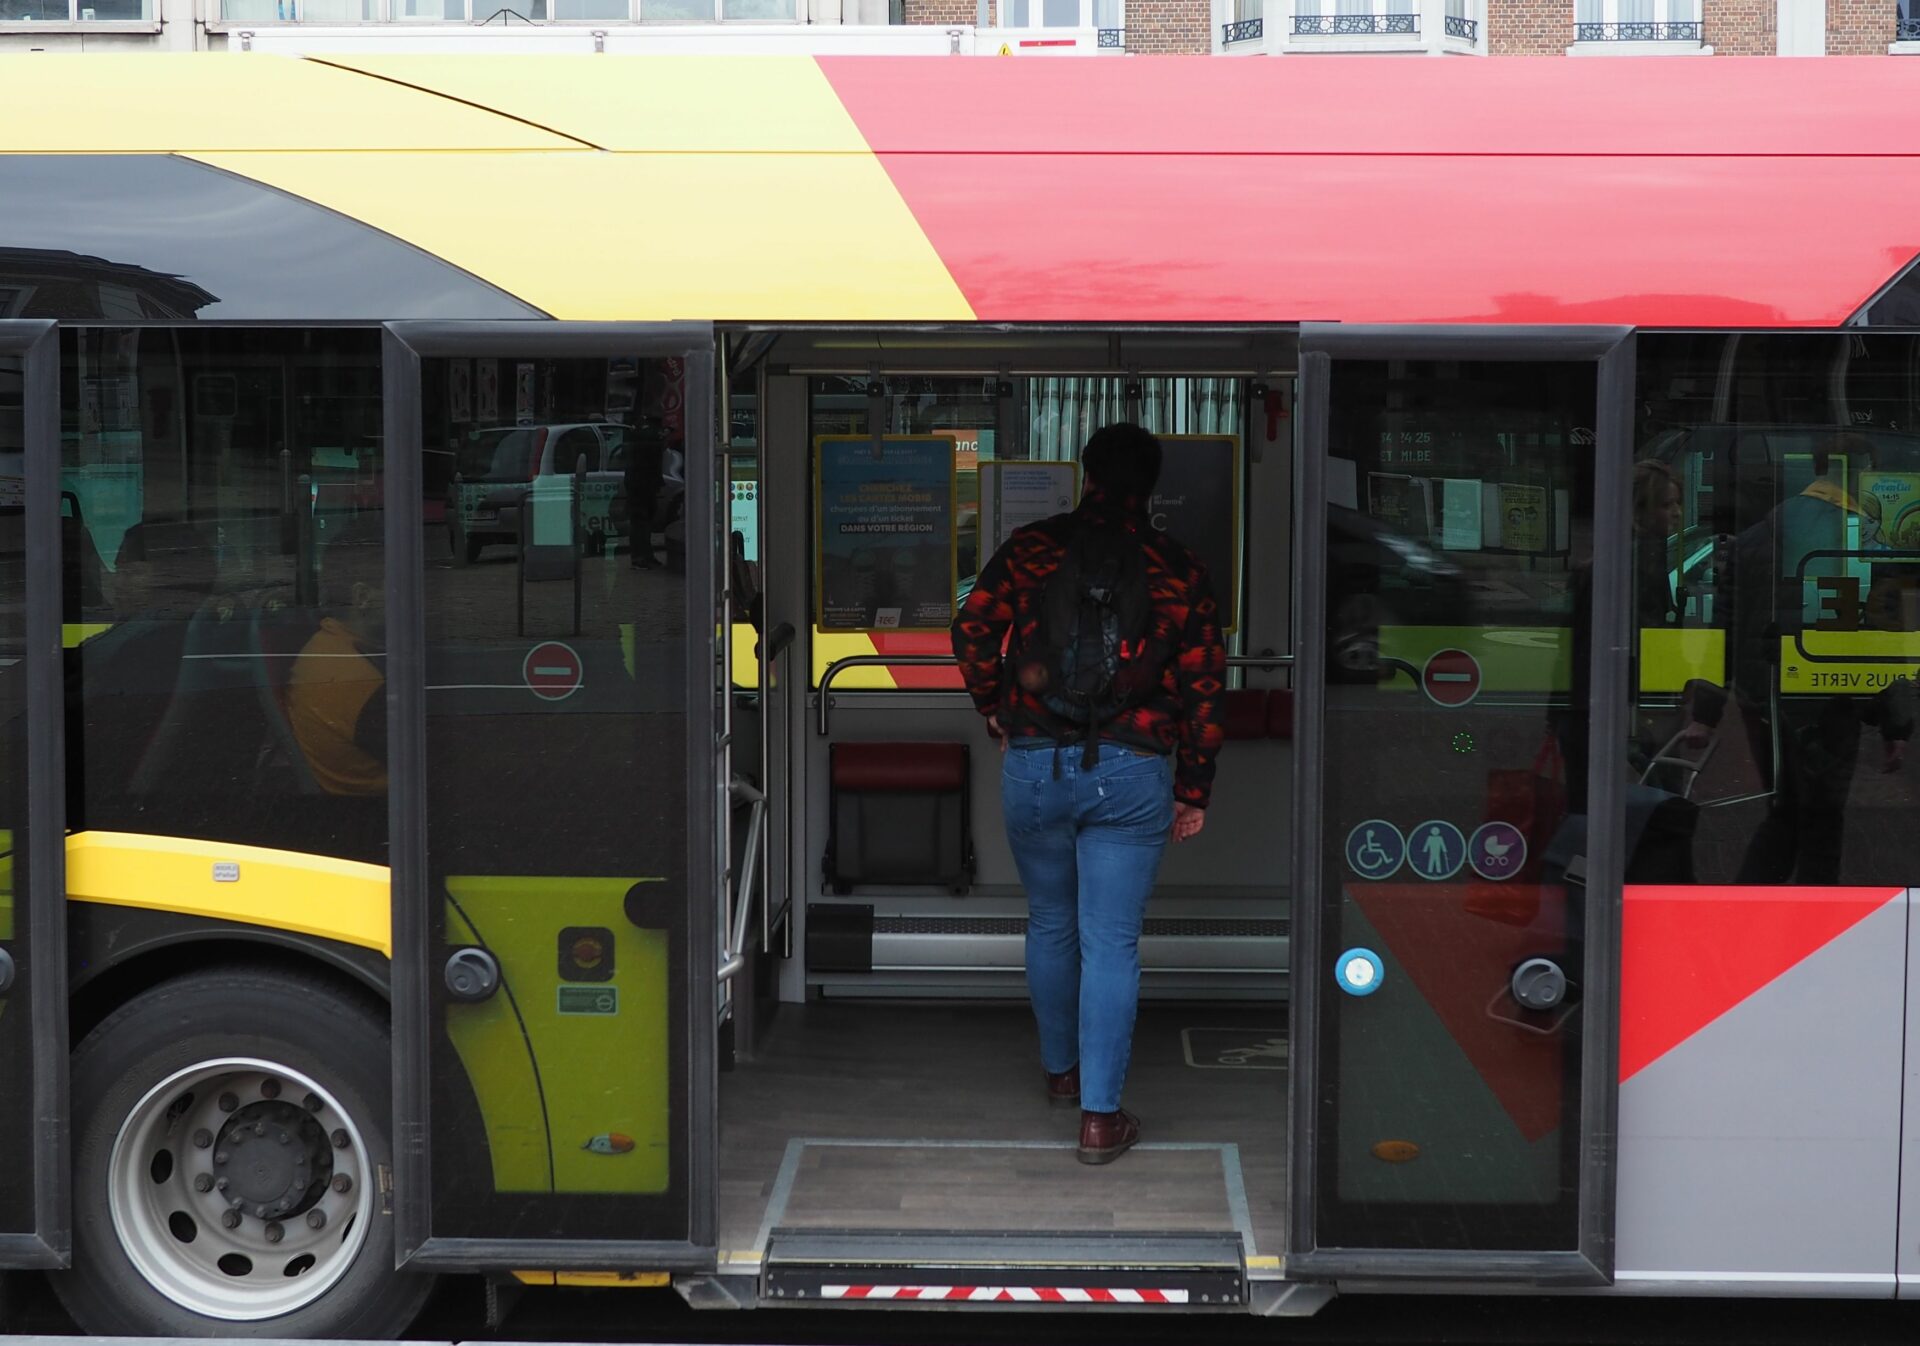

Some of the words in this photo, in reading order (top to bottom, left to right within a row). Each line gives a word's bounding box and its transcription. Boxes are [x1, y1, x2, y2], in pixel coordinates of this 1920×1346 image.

[889, 504, 942, 513] abonnement
[890, 514, 914, 522] ticket
[841, 524, 866, 532] DANS
[867, 524, 896, 532] VOTRE
[898, 522, 933, 532] RÉGION
